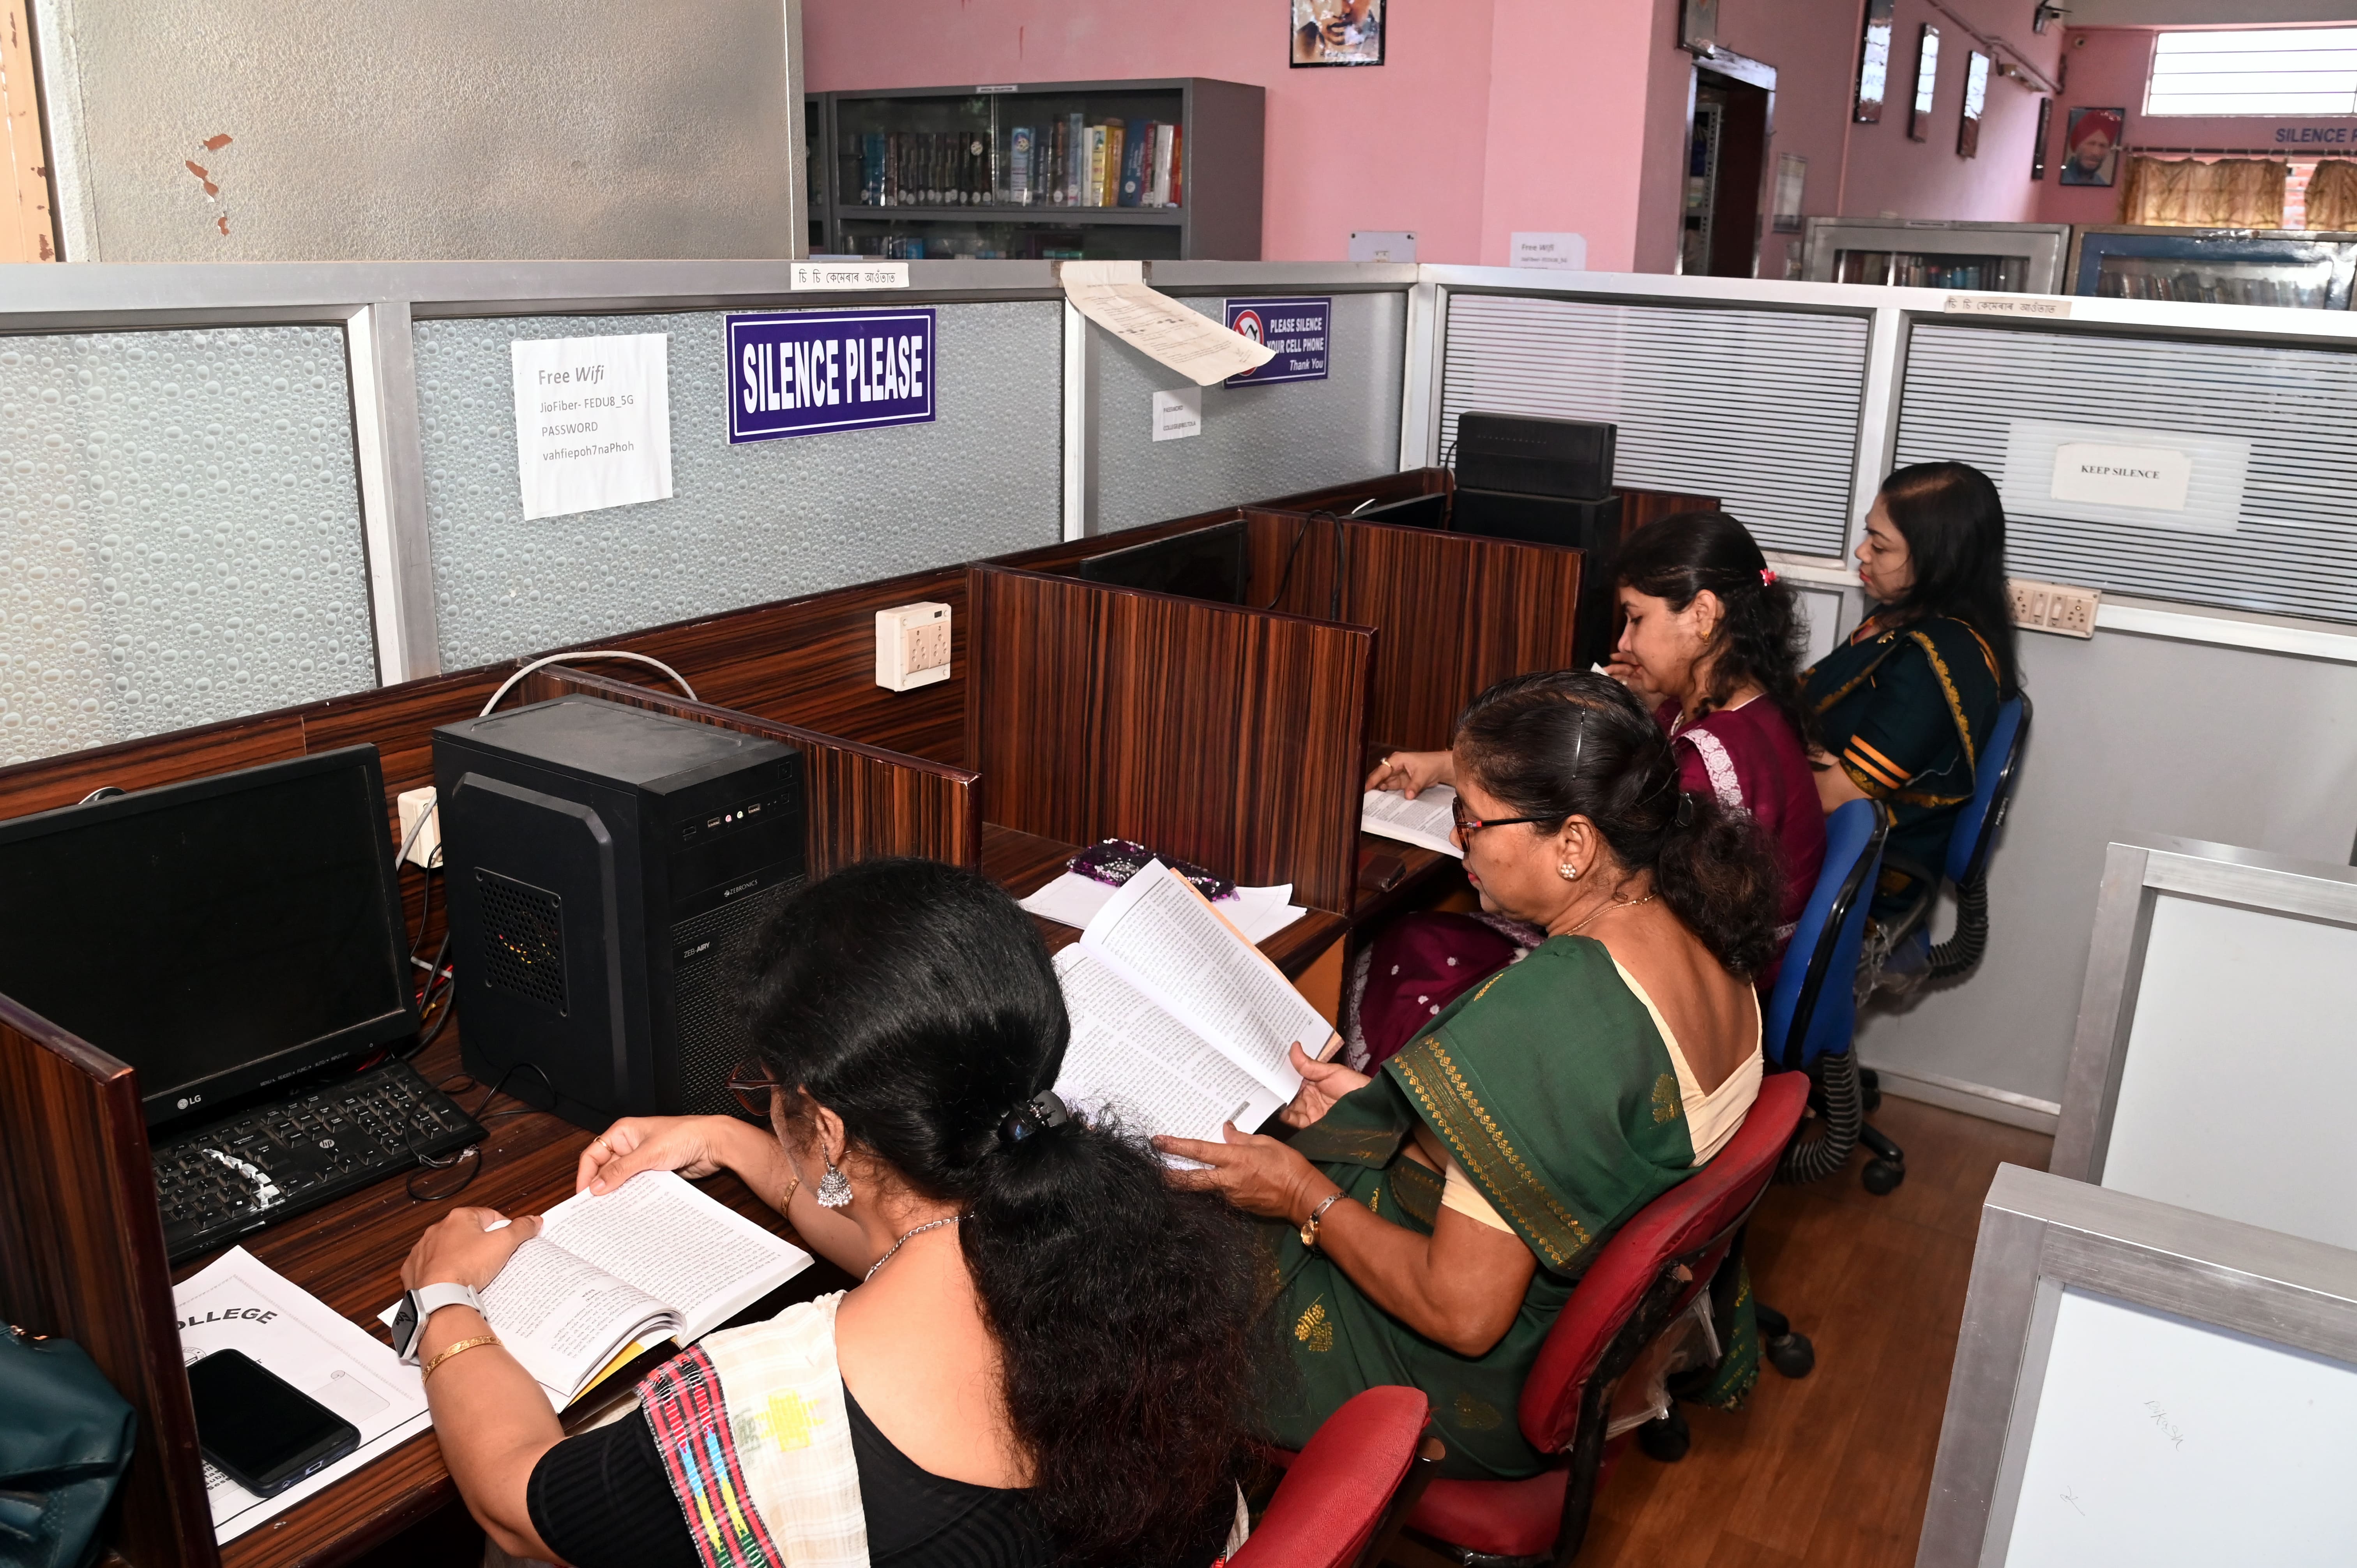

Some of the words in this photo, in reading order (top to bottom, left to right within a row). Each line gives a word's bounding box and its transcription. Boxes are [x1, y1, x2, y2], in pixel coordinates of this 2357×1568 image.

[2276, 128, 2347, 143] SILENCE
[799, 268, 807, 283] চি
[813, 269, 821, 283] চি
[1270, 318, 1295, 333] PLEASE
[1295, 317, 1322, 332] SILENCE
[1267, 340, 1285, 353] YOUR
[1286, 339, 1302, 353] CELL
[1302, 337, 1324, 352] PHONE
[1290, 358, 1310, 371] Thank
[1311, 358, 1324, 369] You
[539, 369, 570, 385] Free
[575, 365, 604, 384] Wifi
[743, 339, 839, 414] SILENCE
[845, 335, 923, 403] PLEASE
[540, 400, 581, 413] JioFiber-
[584, 395, 634, 410] FEDU8_5G
[542, 421, 598, 437] PASSWORD
[543, 441, 634, 461] vahfiepoh7naPhoh
[2081, 465, 2110, 475] KEEP
[2112, 468, 2159, 479] SILENCE
[730, 879, 758, 895] ZEBRONICS
[684, 941, 710, 958] ZEB-AIRY
[189, 1094, 201, 1105] LG
[320, 1139, 334, 1148] hp
